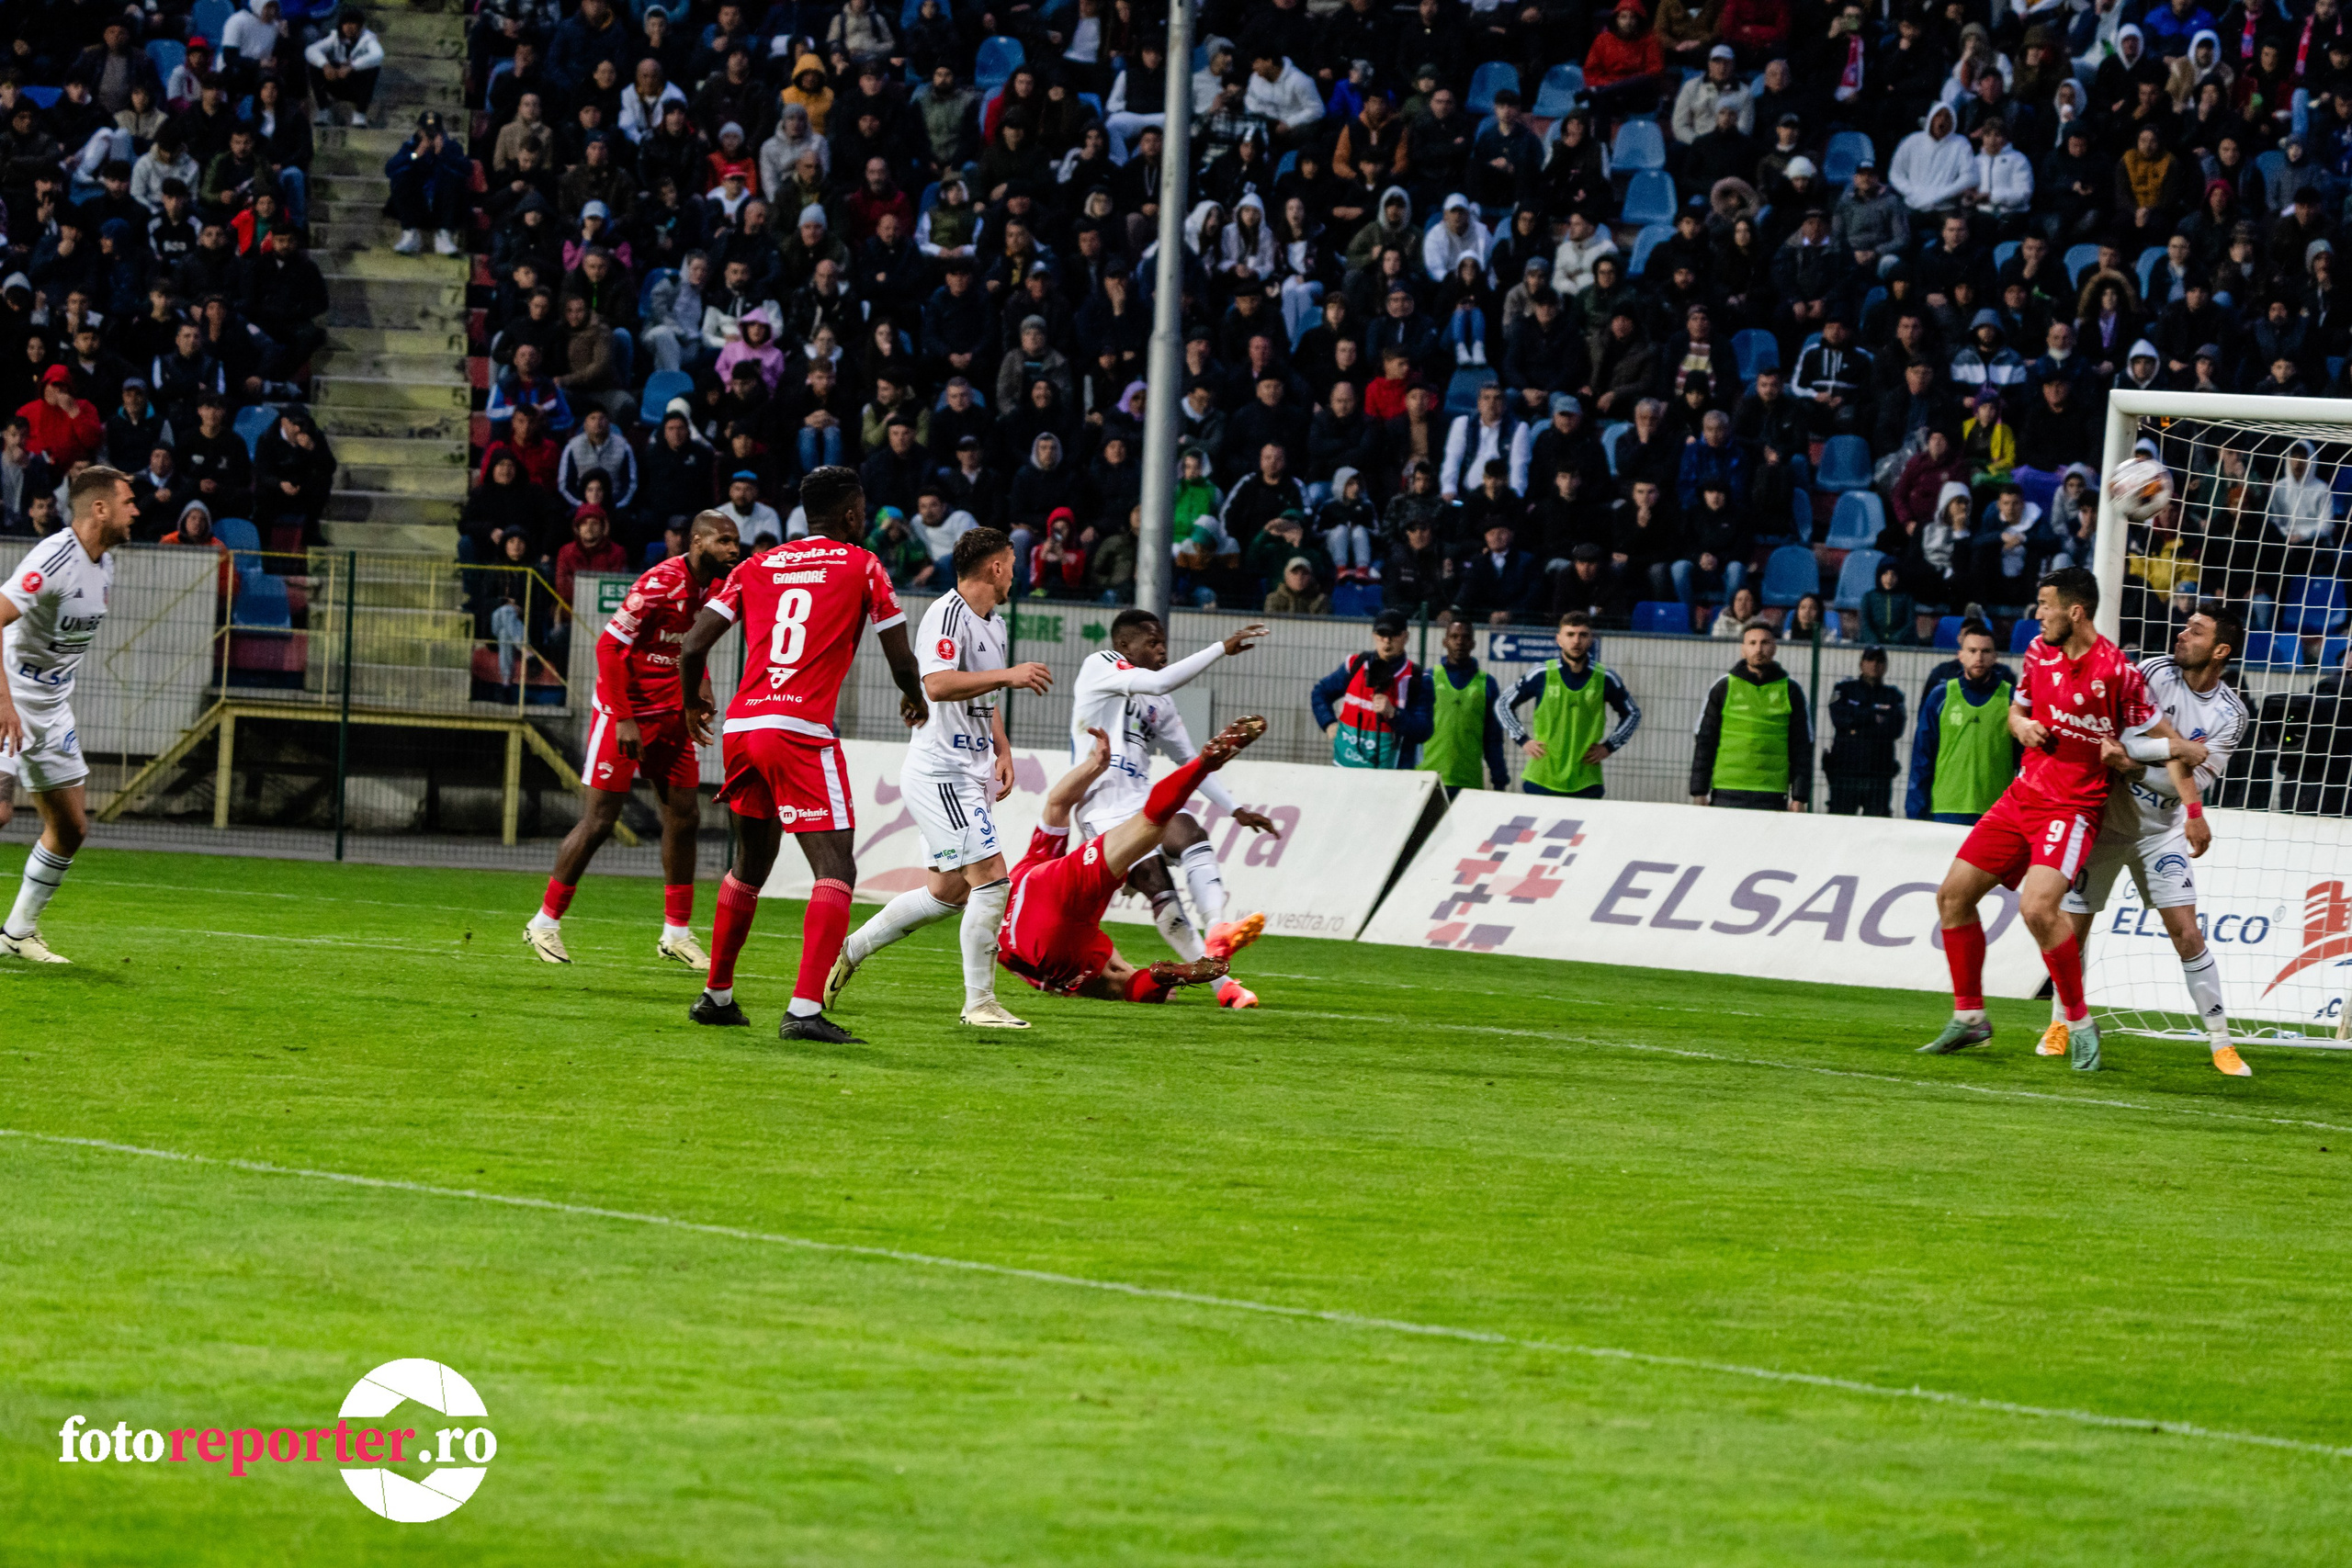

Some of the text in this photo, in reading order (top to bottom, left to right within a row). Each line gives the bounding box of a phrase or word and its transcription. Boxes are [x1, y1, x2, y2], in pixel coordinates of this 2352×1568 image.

[776, 547, 848, 562] Regata.ro
[770, 588, 813, 665] 8
[797, 807, 829, 818] Tehnic
[975, 807, 996, 835] 3
[2045, 819, 2067, 842] 9
